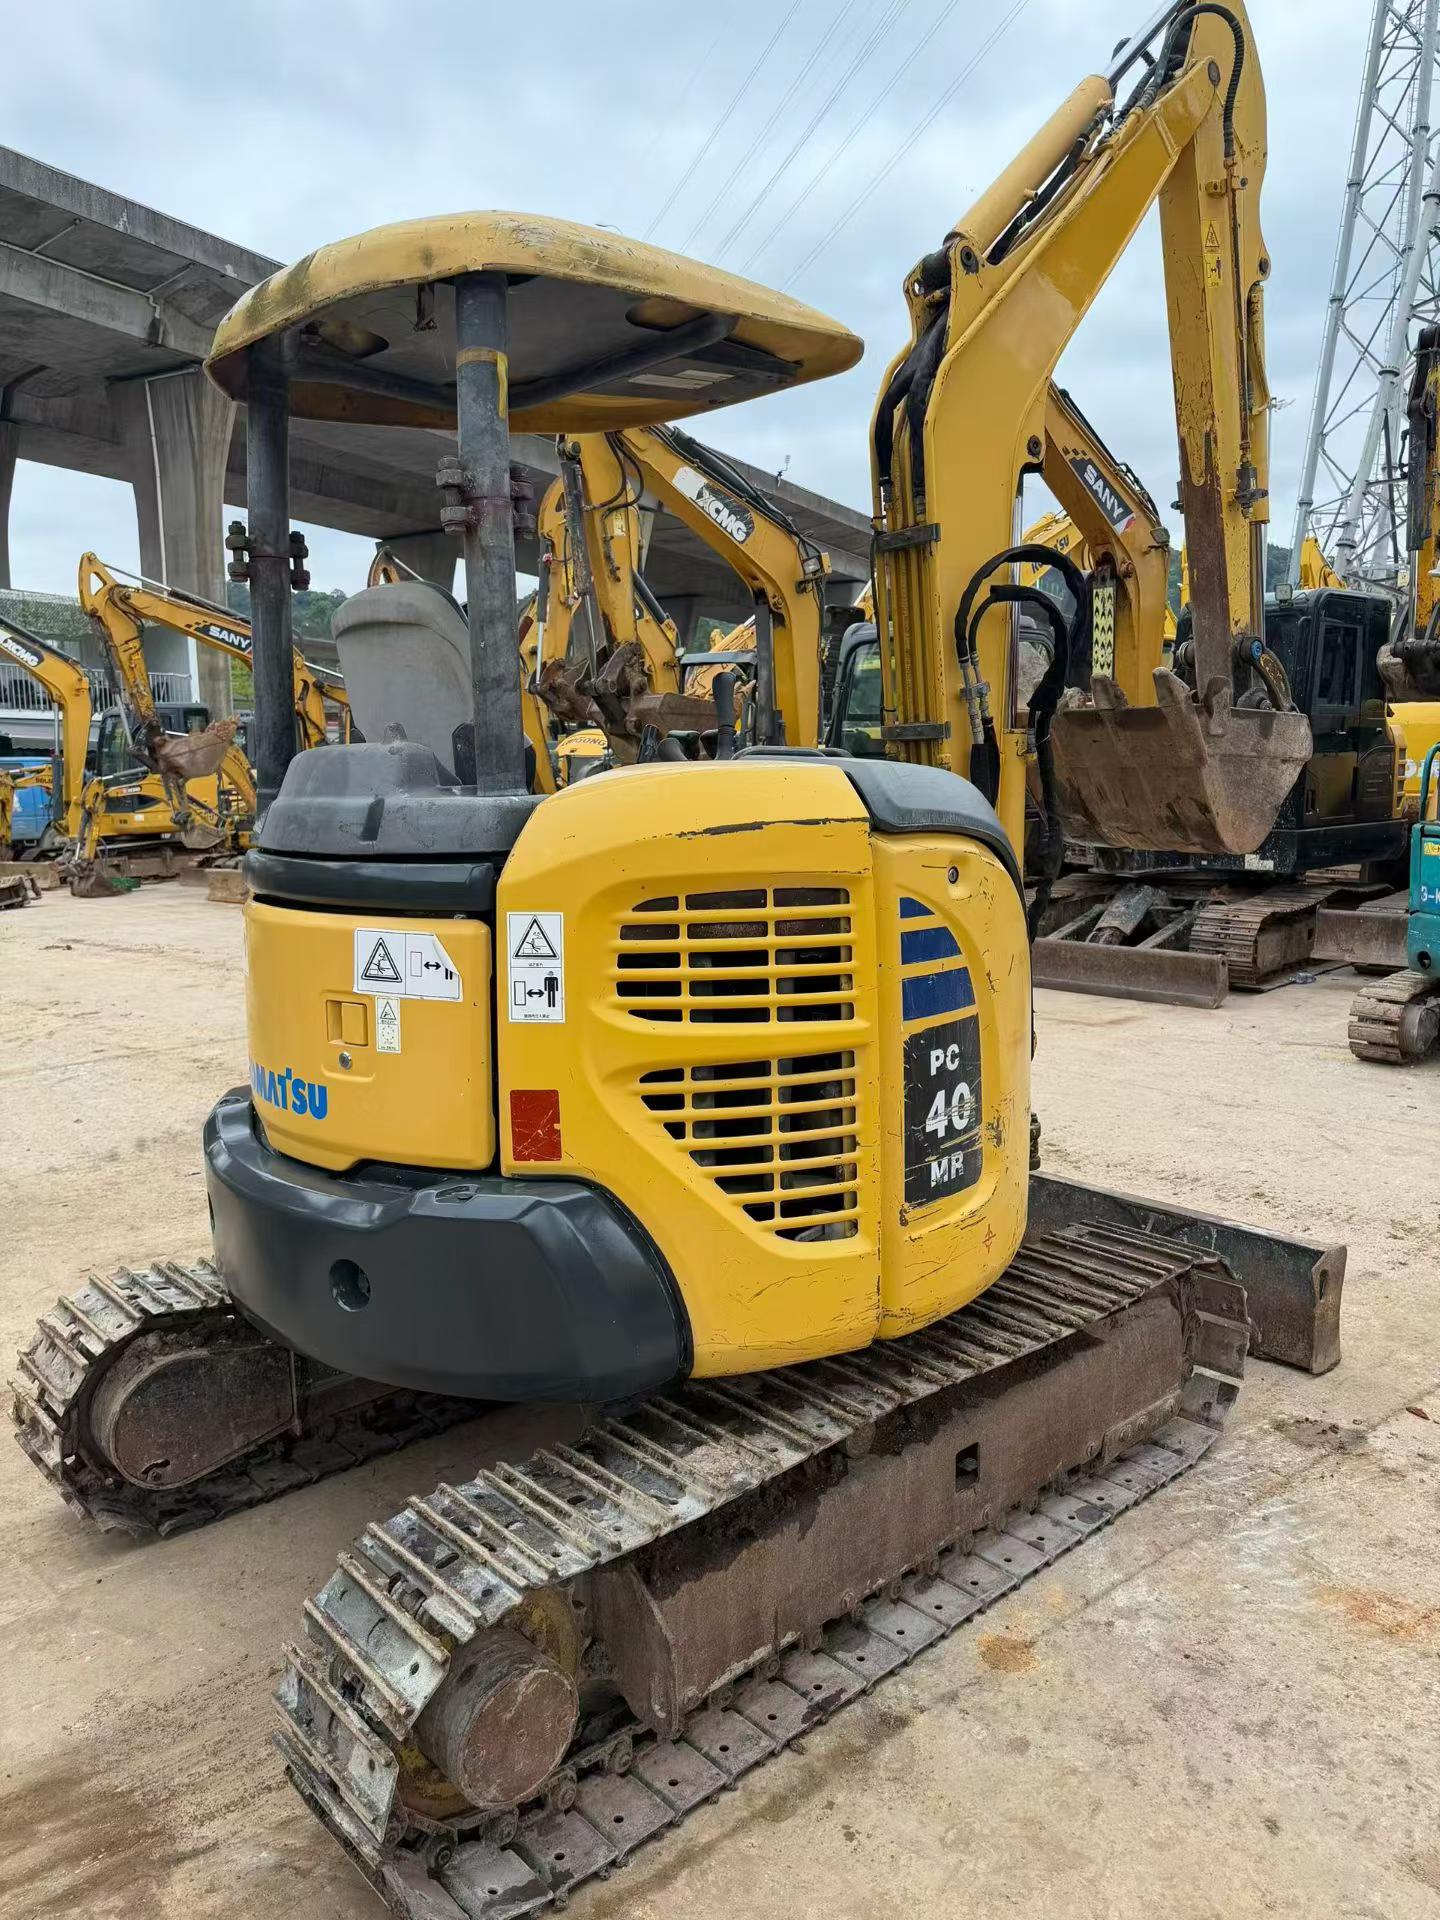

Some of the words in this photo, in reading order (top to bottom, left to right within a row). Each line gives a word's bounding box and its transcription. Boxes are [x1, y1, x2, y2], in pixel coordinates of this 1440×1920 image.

[695, 487, 747, 542] XCMG
[1083, 464, 1124, 519] SANY
[208, 625, 250, 649] SANY
[930, 1043, 960, 1077] PC
[250, 1062, 328, 1120] MATSU
[926, 1081, 971, 1139] 40
[930, 1150, 965, 1188] MR
